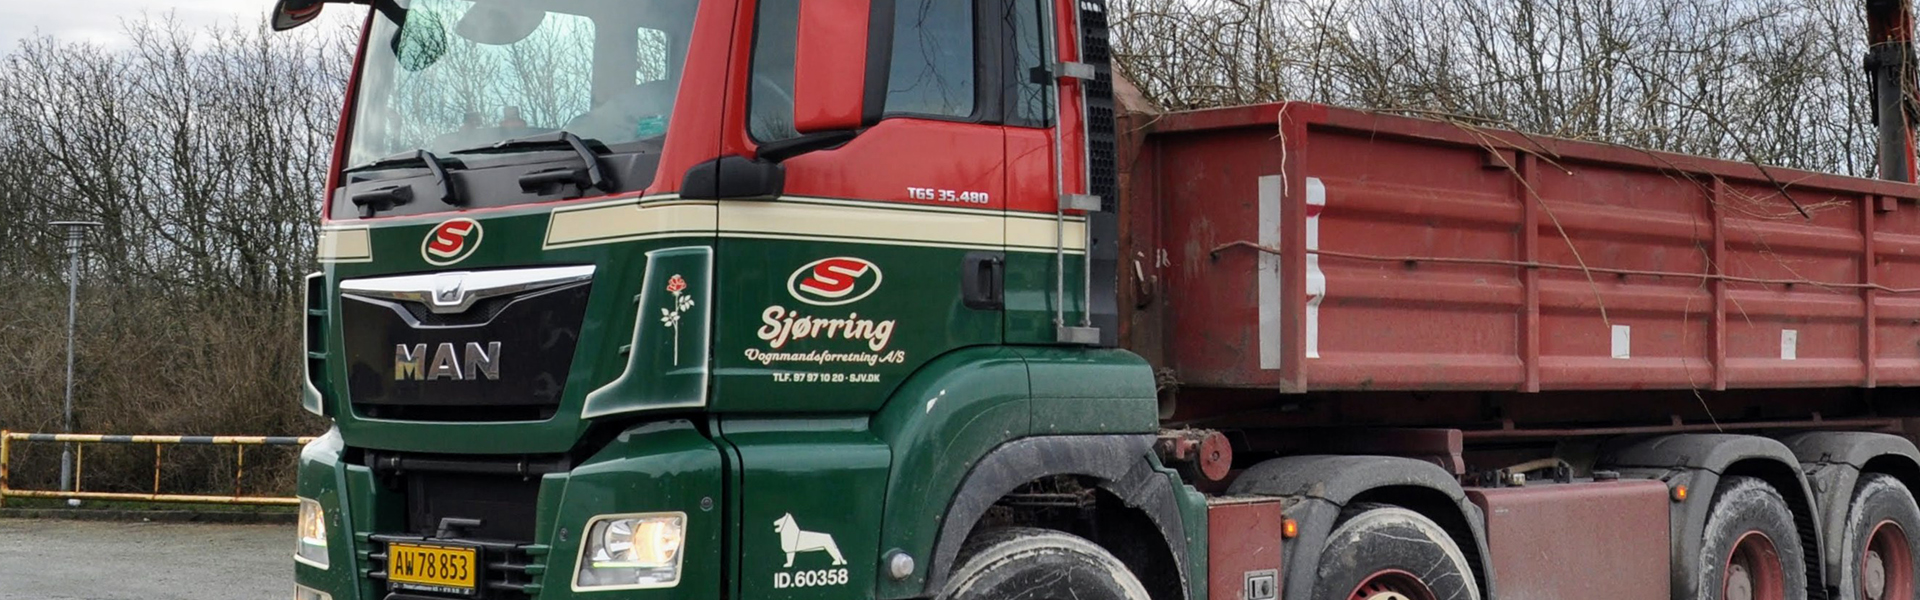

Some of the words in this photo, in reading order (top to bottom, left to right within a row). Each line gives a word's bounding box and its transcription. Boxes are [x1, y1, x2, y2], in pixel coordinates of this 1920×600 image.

[907, 187, 934, 200] TGS
[938, 189, 989, 204] 35.480
[757, 305, 896, 351] Sjørring
[394, 341, 501, 381] MAN
[744, 348, 879, 366] Vognmandsforretning
[879, 350, 906, 363] A/S
[773, 373, 792, 382] TLF.
[793, 373, 805, 382] 97
[806, 373, 818, 382] 97
[820, 373, 831, 382] 10
[832, 373, 844, 382] 20
[850, 374, 880, 383] SJV.DK
[394, 550, 414, 576] AW
[418, 552, 436, 578] 78
[440, 553, 468, 581] 853
[774, 568, 849, 589] ID.60358
